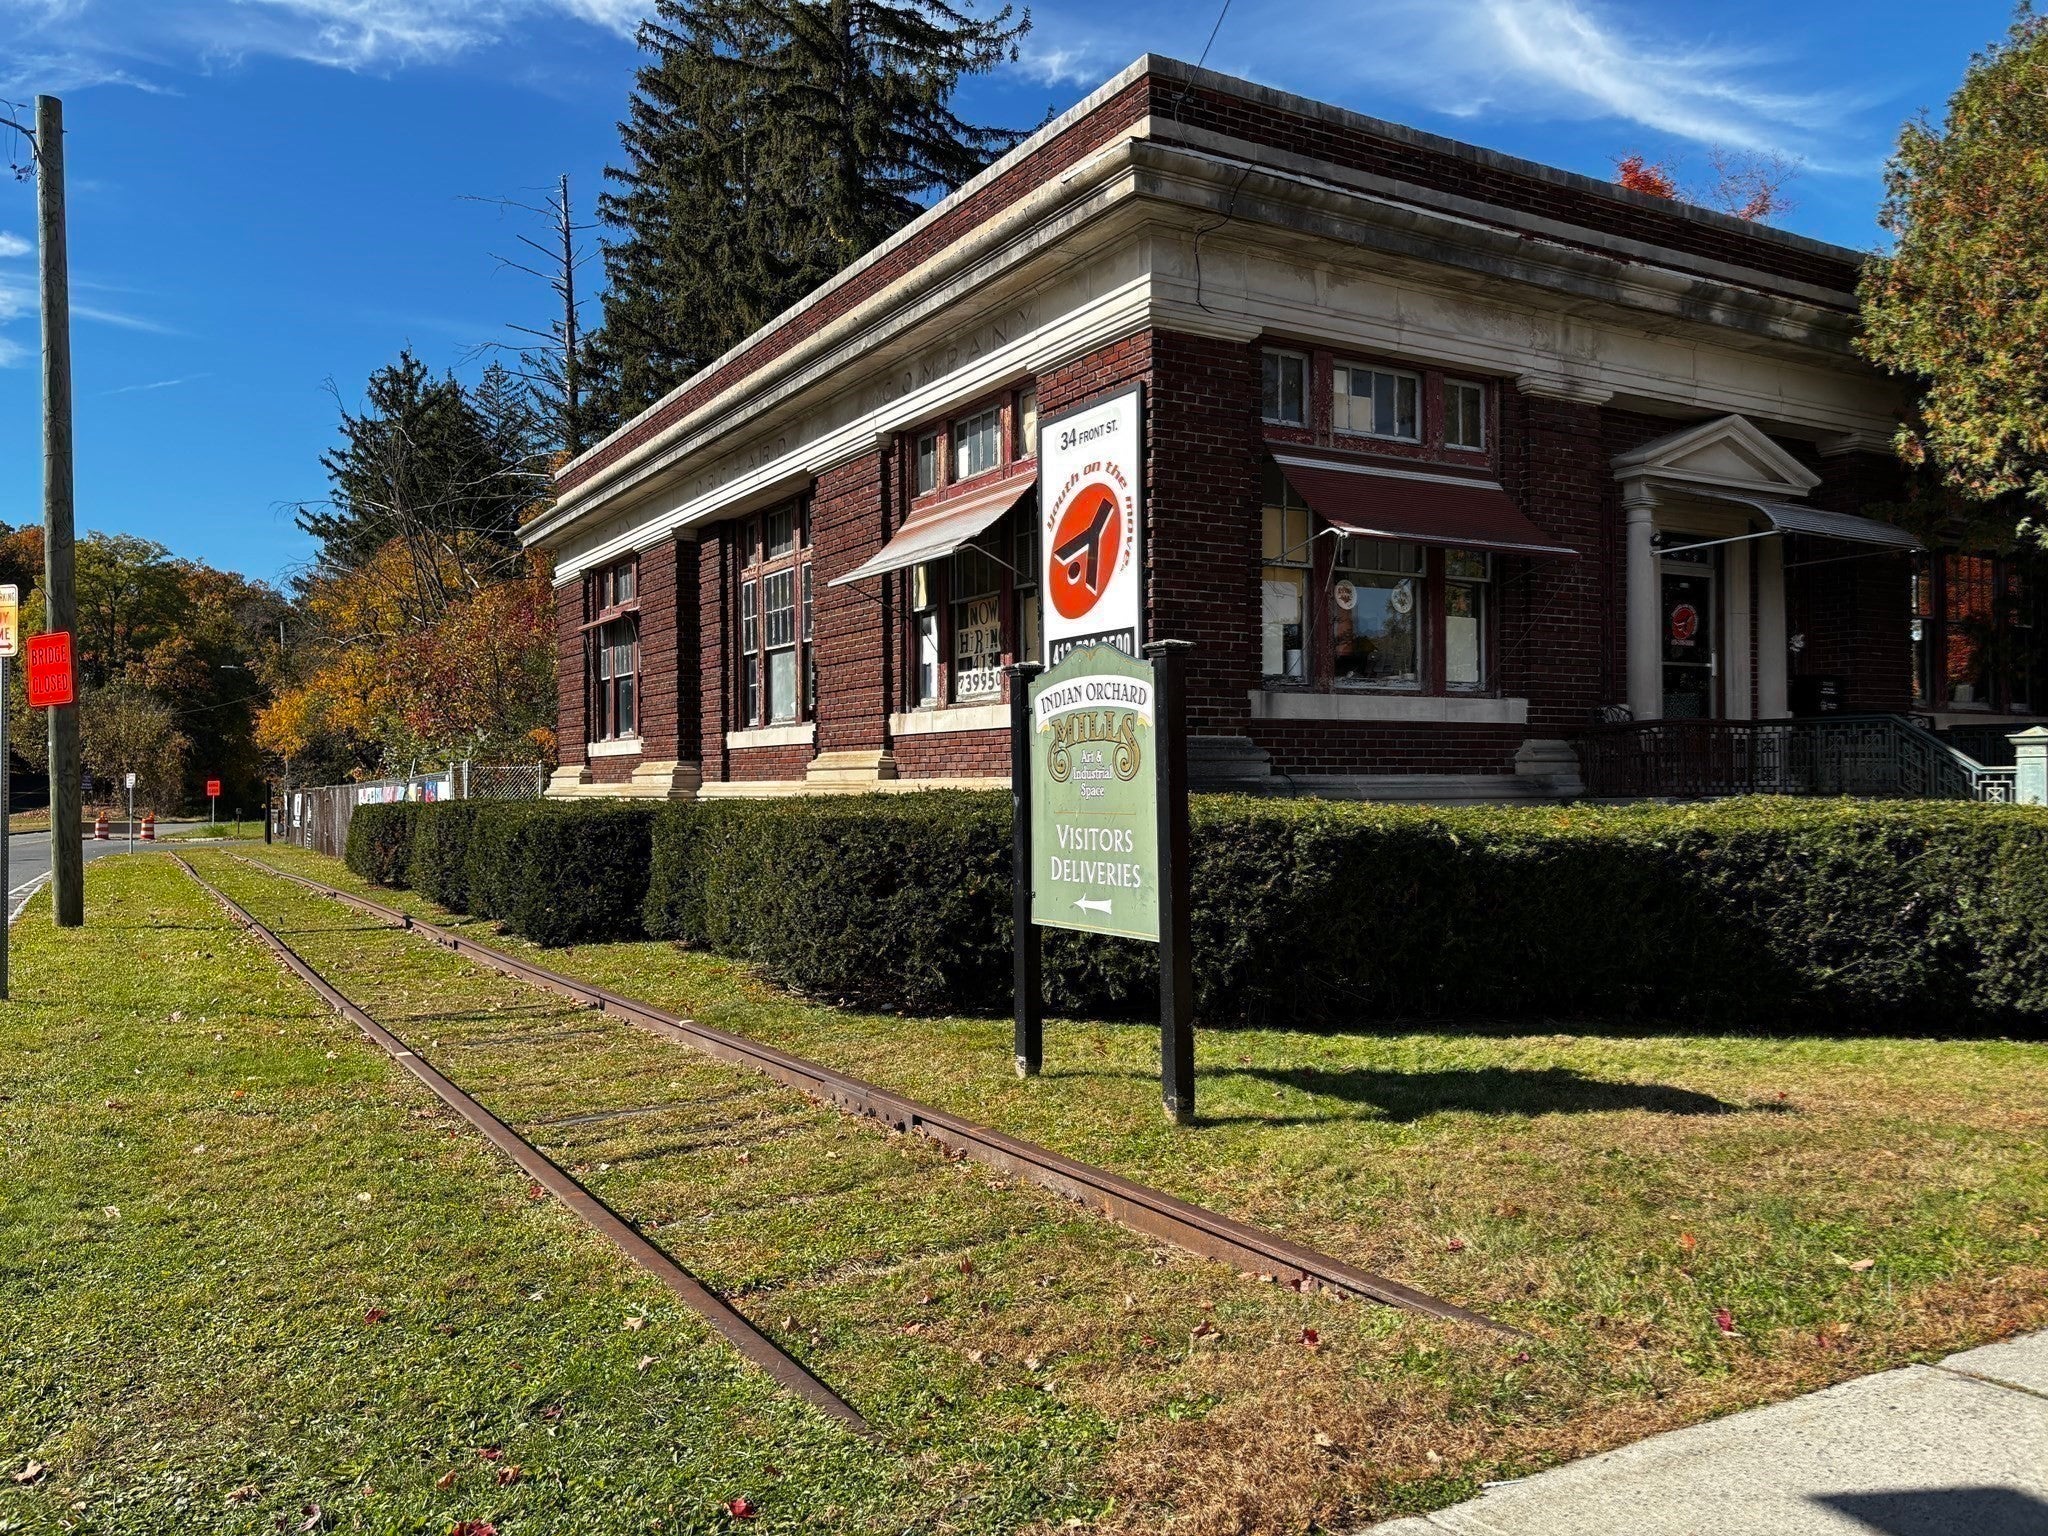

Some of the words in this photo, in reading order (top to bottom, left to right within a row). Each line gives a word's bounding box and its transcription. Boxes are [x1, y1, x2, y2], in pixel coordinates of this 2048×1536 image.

[1060, 428, 1077, 450] 34
[1078, 424, 1104, 444] FRONT
[1106, 419, 1118, 434] ST.
[1047, 472, 1079, 532] youth
[1083, 461, 1101, 475] on
[1105, 461, 1128, 490] the
[1123, 496, 1134, 567] move
[969, 599, 998, 625] NOW
[32, 645, 66, 666] BRIDGE
[973, 652, 993, 673] 413
[33, 674, 68, 694] CLOSED
[1041, 684, 1082, 714] INDIAN
[1086, 681, 1147, 706] ORCHARD
[1081, 750, 1095, 763] Art
[1072, 765, 1113, 781] Industrial
[1080, 784, 1104, 800] Space
[1056, 824, 1133, 853] VISITORS
[1051, 856, 1141, 888] DELIVERIES
